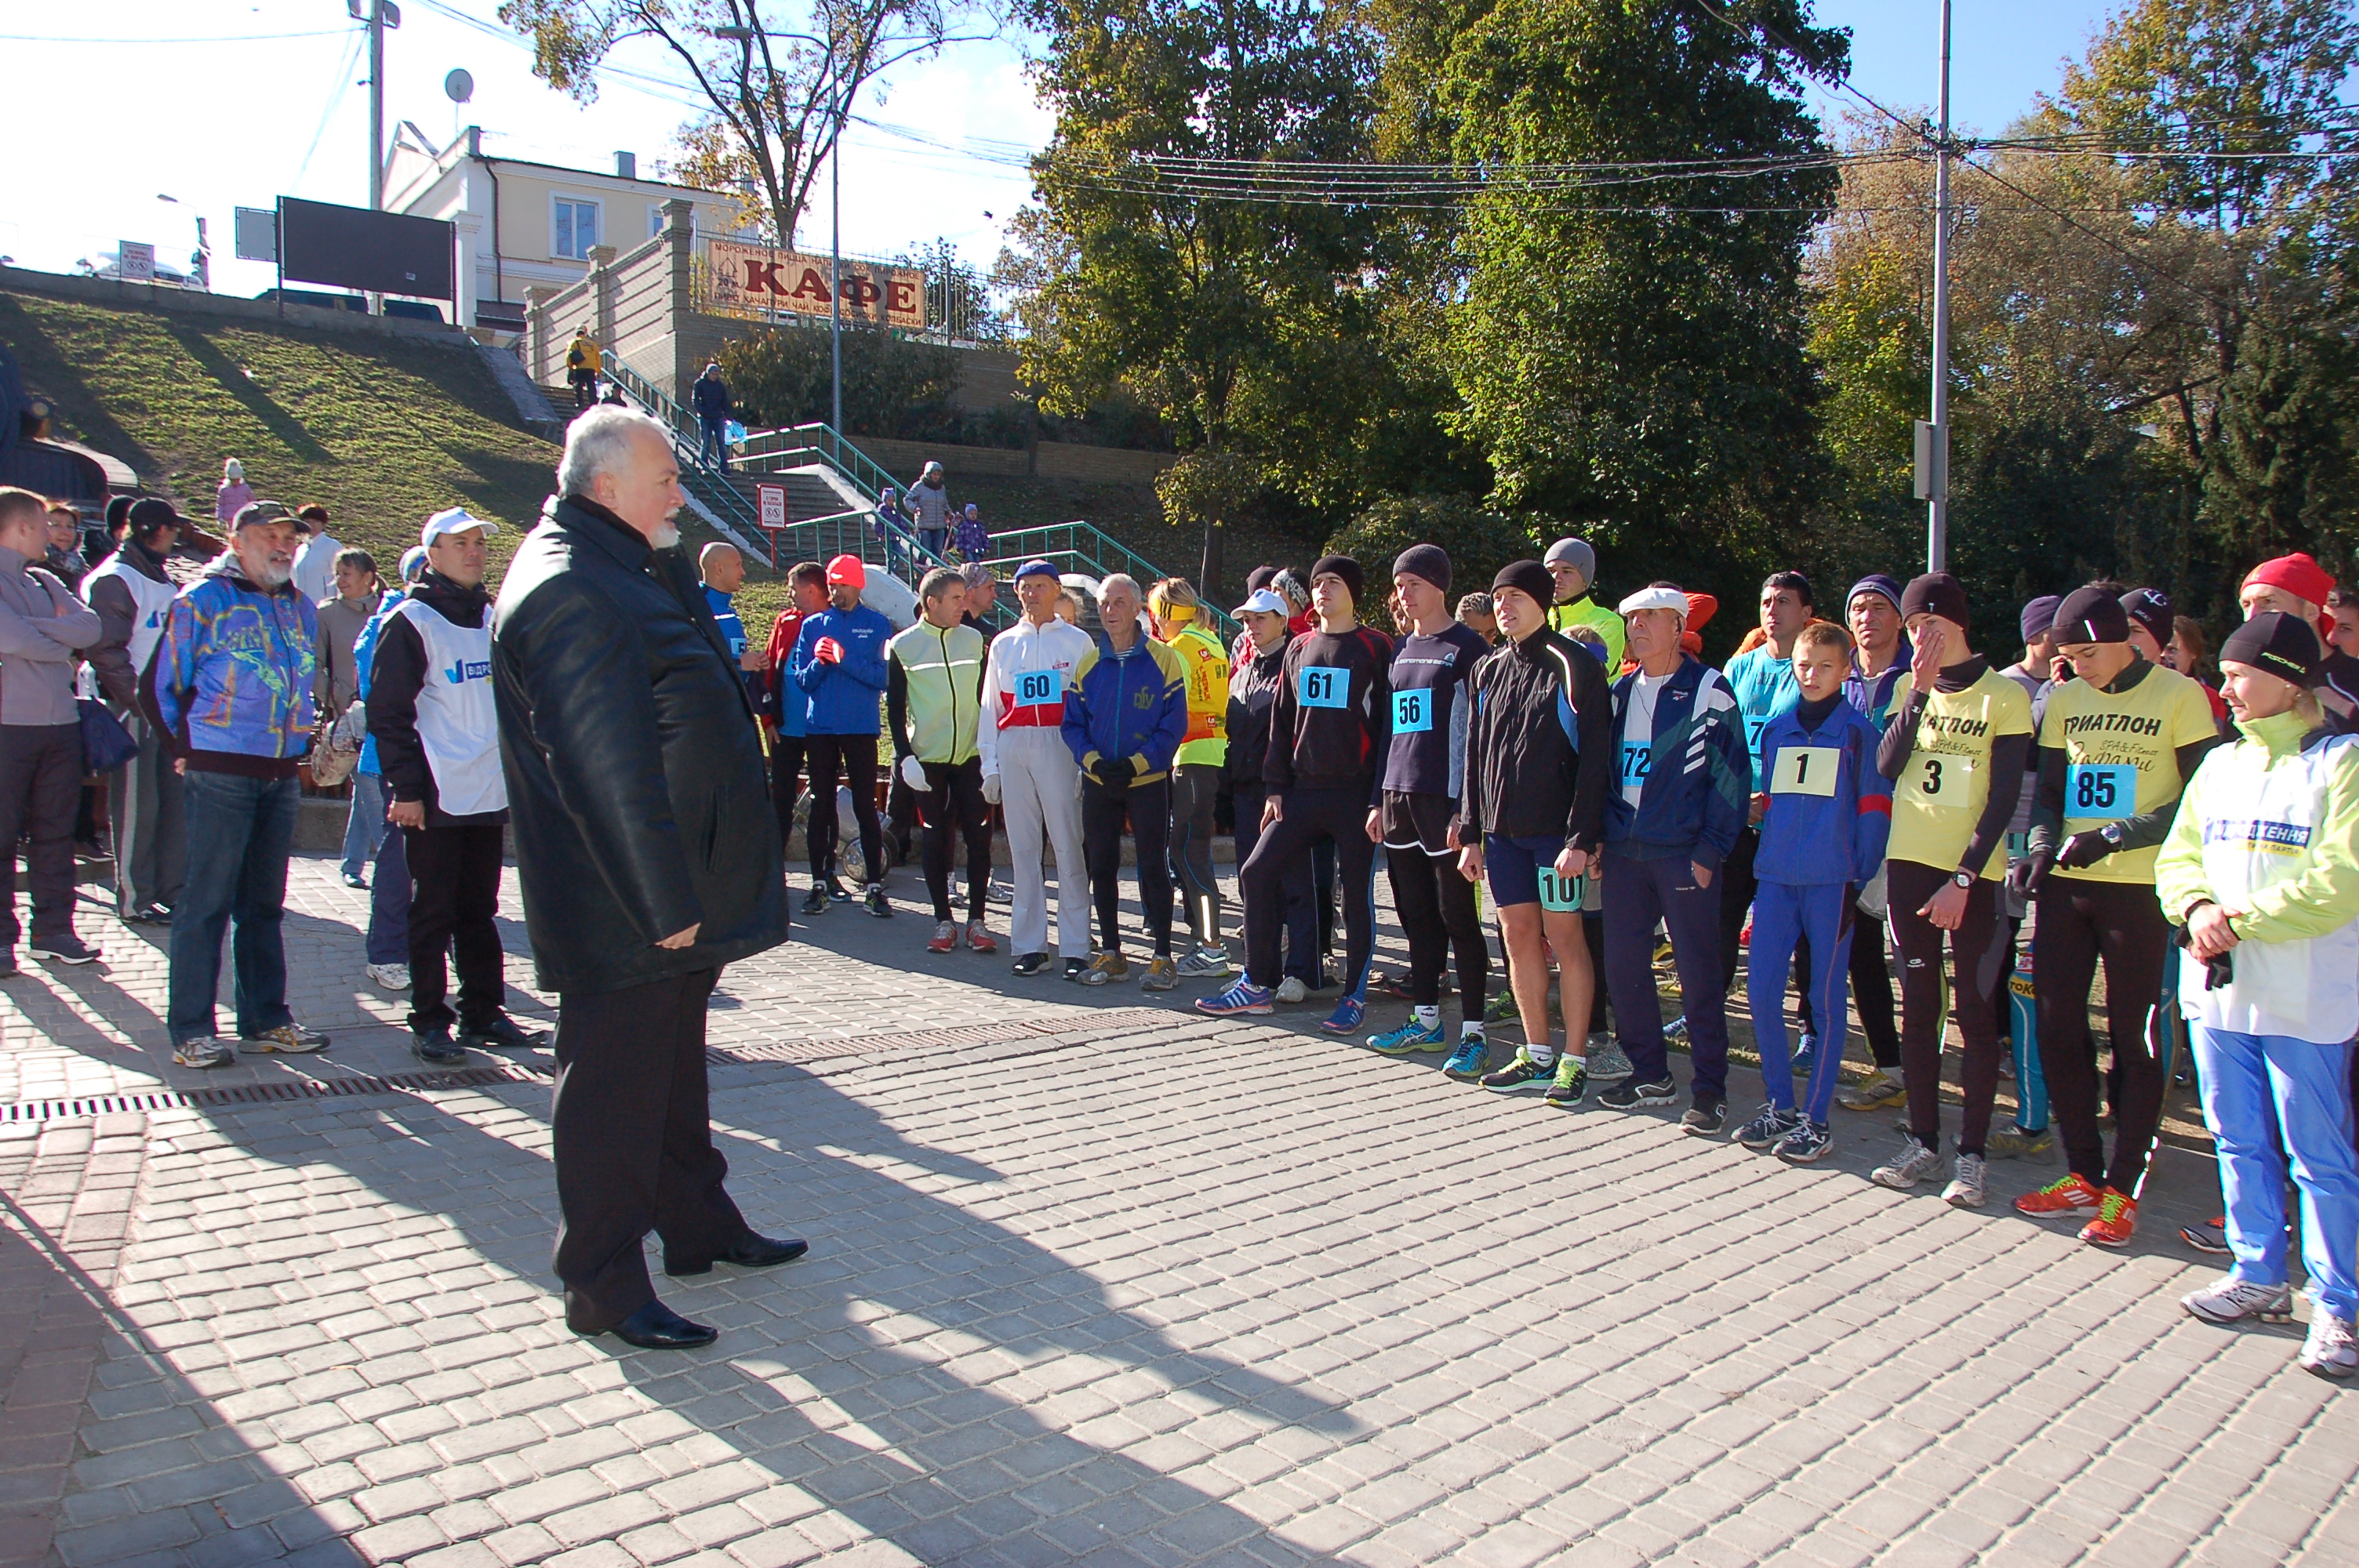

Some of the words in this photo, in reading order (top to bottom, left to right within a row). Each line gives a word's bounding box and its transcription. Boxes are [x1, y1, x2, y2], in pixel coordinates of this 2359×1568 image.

[714, 243, 773, 258] МОРОЖЕНОЕ
[778, 252, 807, 263] ПИЦЦА
[855, 263, 871, 273] СОК
[874, 267, 920, 280] ПИРОЖНОЕ
[718, 278, 729, 287] 20
[744, 260, 916, 314] КАФЕ
[714, 292, 739, 302] ПИВО
[743, 295, 789, 307] ХАЧАПУРИ
[813, 303, 832, 314] КОФ
[839, 308, 877, 320] СОСИСКИ
[881, 314, 921, 326] КОЛБАСКИ
[1023, 675, 1050, 699] 60
[1307, 672, 1332, 699] 61
[1399, 695, 1420, 725] 56
[2063, 713, 2161, 737] ТРИАТЛОН
[1623, 747, 1651, 778] 72
[1796, 753, 1809, 784] 1
[1922, 759, 1943, 794] 3
[2077, 771, 2116, 808] 85
